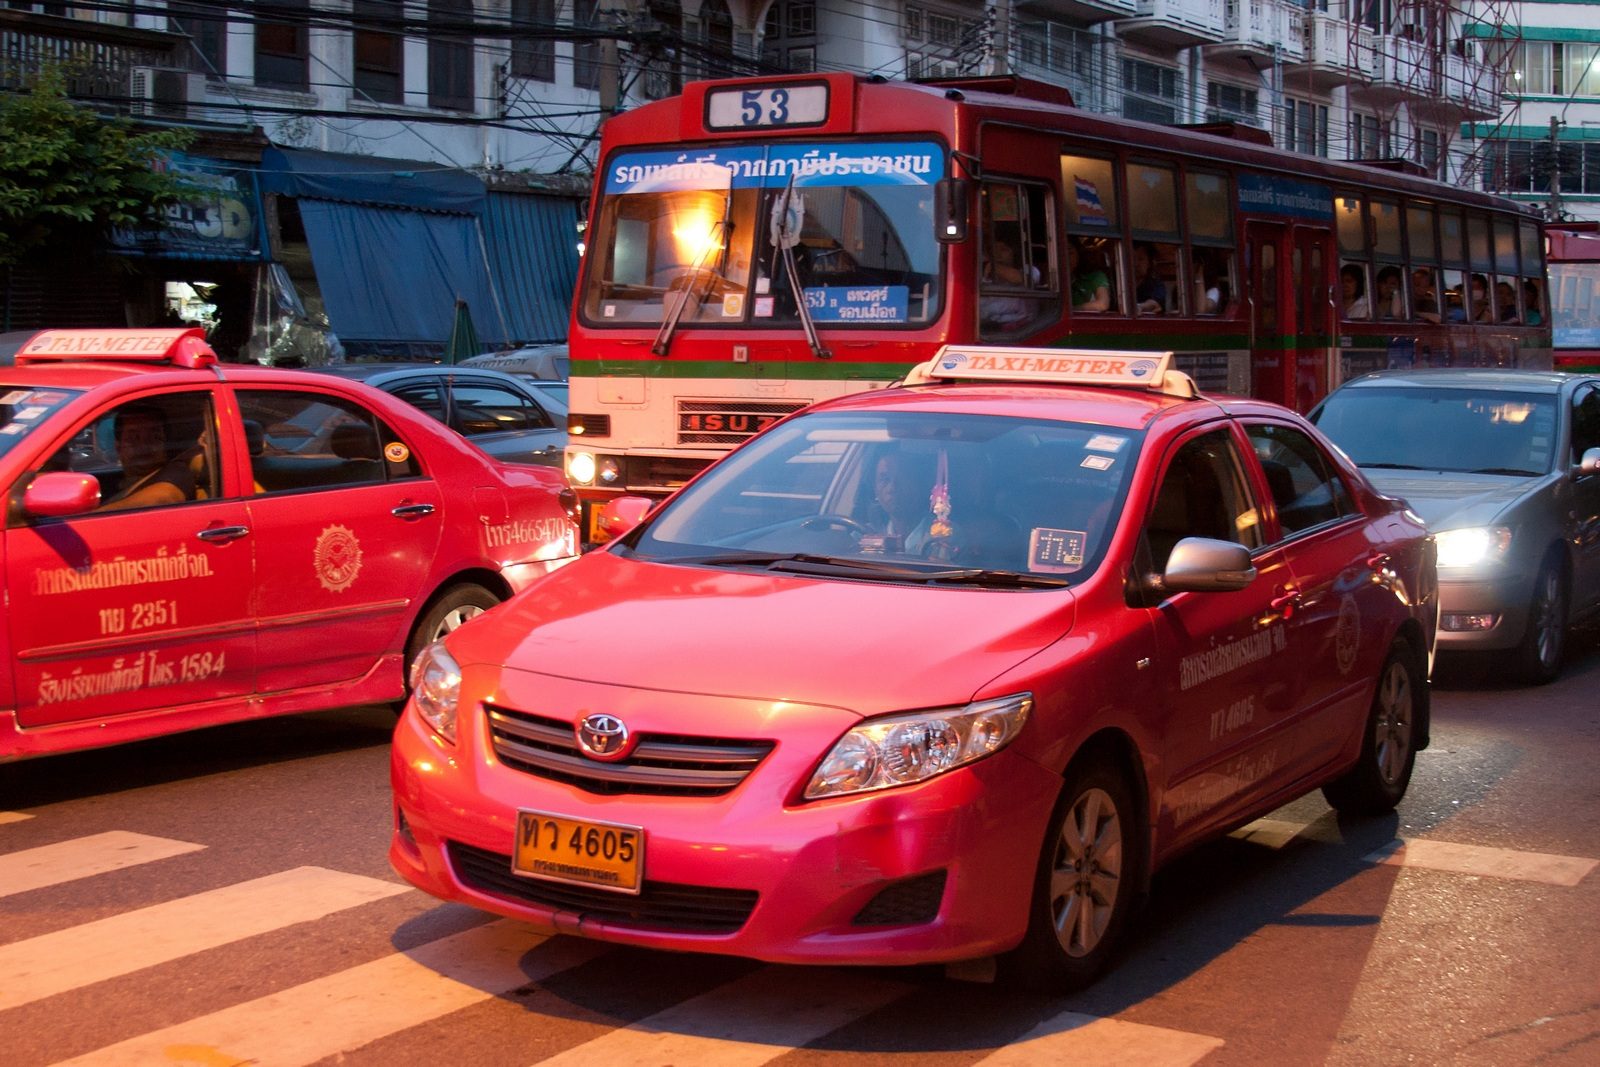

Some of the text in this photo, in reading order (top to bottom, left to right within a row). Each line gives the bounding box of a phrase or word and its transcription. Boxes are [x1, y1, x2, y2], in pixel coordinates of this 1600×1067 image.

[741, 89, 789, 125] 53
[48, 337, 174, 351] TAXI-METER
[969, 356, 1126, 375] TAXI-METER
[131, 600, 177, 630] 2351
[178, 651, 226, 682] 1584
[521, 818, 634, 863] ทว 4605
